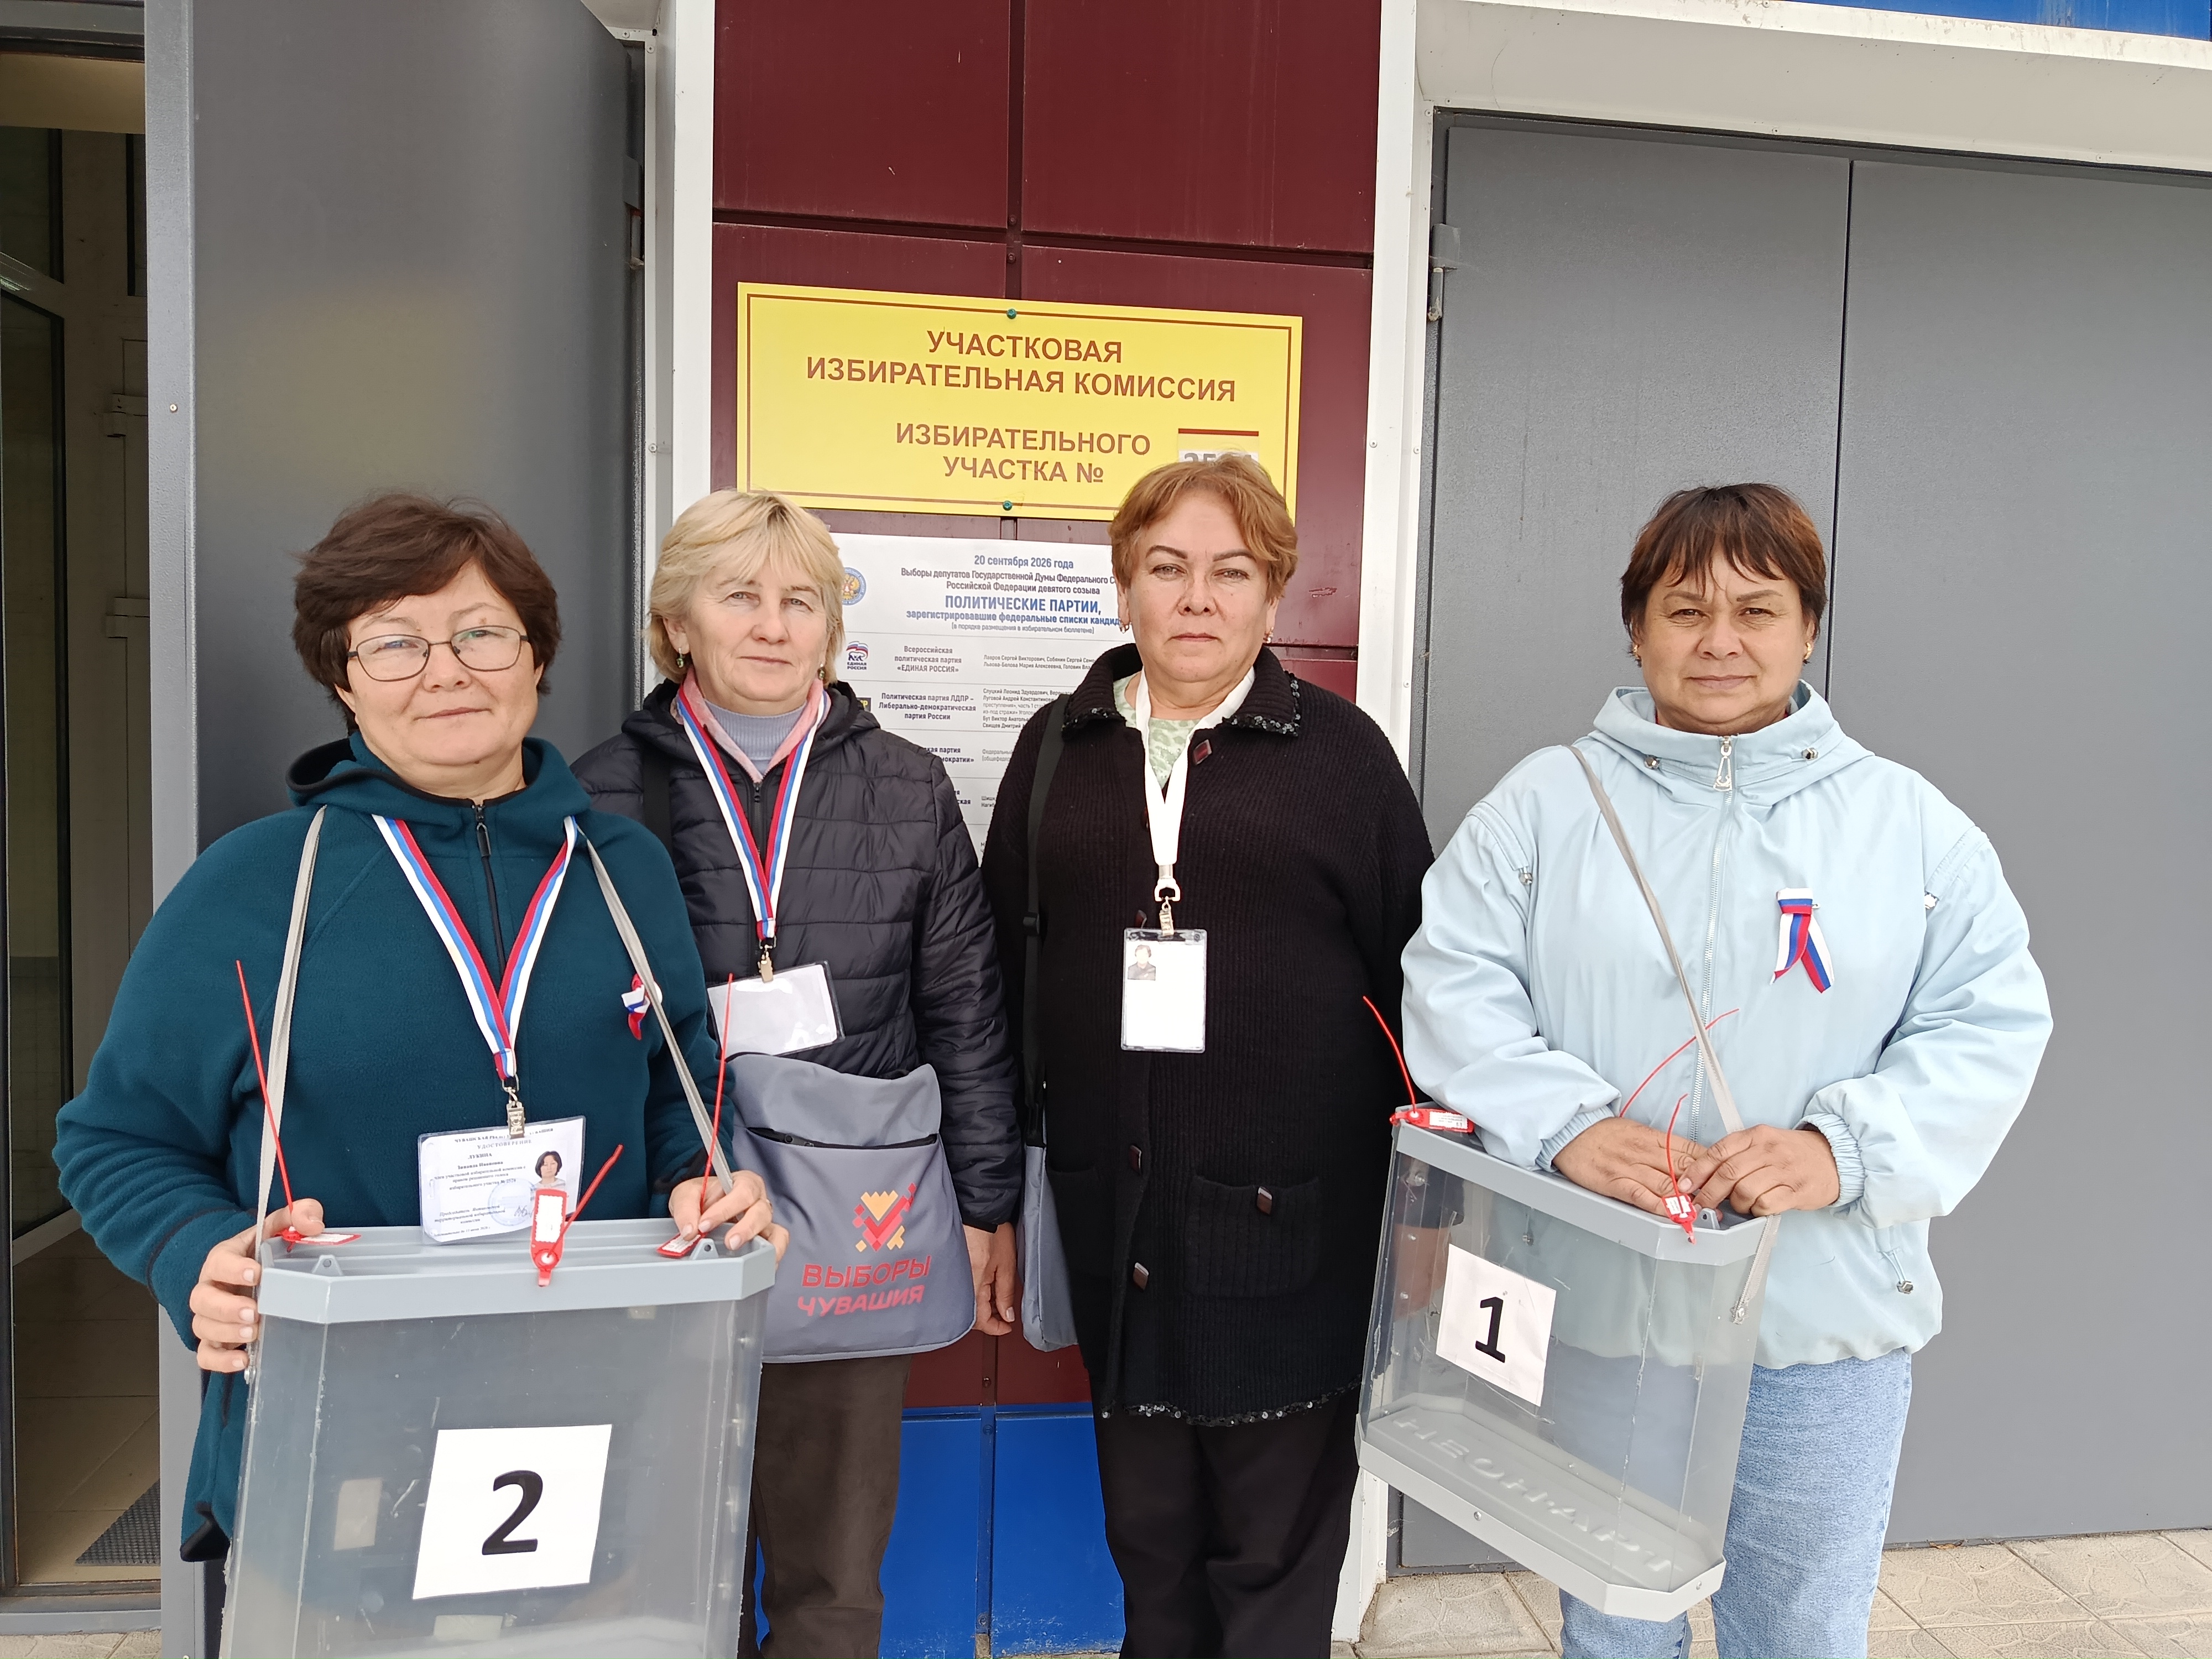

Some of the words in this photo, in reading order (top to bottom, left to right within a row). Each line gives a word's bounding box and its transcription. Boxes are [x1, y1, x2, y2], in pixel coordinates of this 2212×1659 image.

[927, 330, 1123, 363] УЧАСТКОВАЯ
[807, 357, 1063, 394] ИЗБИРАТЕЛЬНАЯ
[1074, 373, 1235, 402] КОМИССИЯ
[895, 423, 1150, 456] ИЗБИРАТЕЛЬНОГО
[943, 456, 1067, 483] УЧАСТКА
[1076, 462, 1104, 484] №
[974, 555, 985, 565] 20
[987, 556, 1029, 568] сентября
[1031, 557, 1052, 567] 2026
[1053, 560, 1074, 570] года
[901, 567, 932, 578] Выборы
[933, 571, 970, 579] депутатов
[972, 570, 1033, 581] Государственной
[1035, 573, 1055, 582] Думы
[1057, 573, 1108, 584] Федерального
[946, 581, 992, 590] Российской
[993, 582, 1036, 592] Федерации
[1038, 585, 1071, 593] девятого
[1073, 586, 1100, 594] созыва
[945, 595, 1046, 611] ПОЛИТИЧЕСКИЕ
[1050, 599, 1101, 615] ПАРТИИ,
[906, 611, 997, 621] зарегистрировавшие
[999, 612, 1057, 623] федеральные
[1059, 616, 1088, 625] списки
[1091, 617, 1120, 626] кандид
[1064, 626, 1094, 634] бюллетене)
[904, 645, 953, 654] Всероссийская
[881, 692, 926, 701] Политическая
[879, 702, 976, 712] Либерально-демократическая
[477, 1139, 532, 1150] УДОСТОВЕРЕНИЕ
[801, 1255, 932, 1288] ВЫБОРЫ
[797, 1284, 926, 1317] ЧУВАШИЯ
[1475, 1296, 1506, 1363] 1
[482, 1469, 544, 1556] 2
